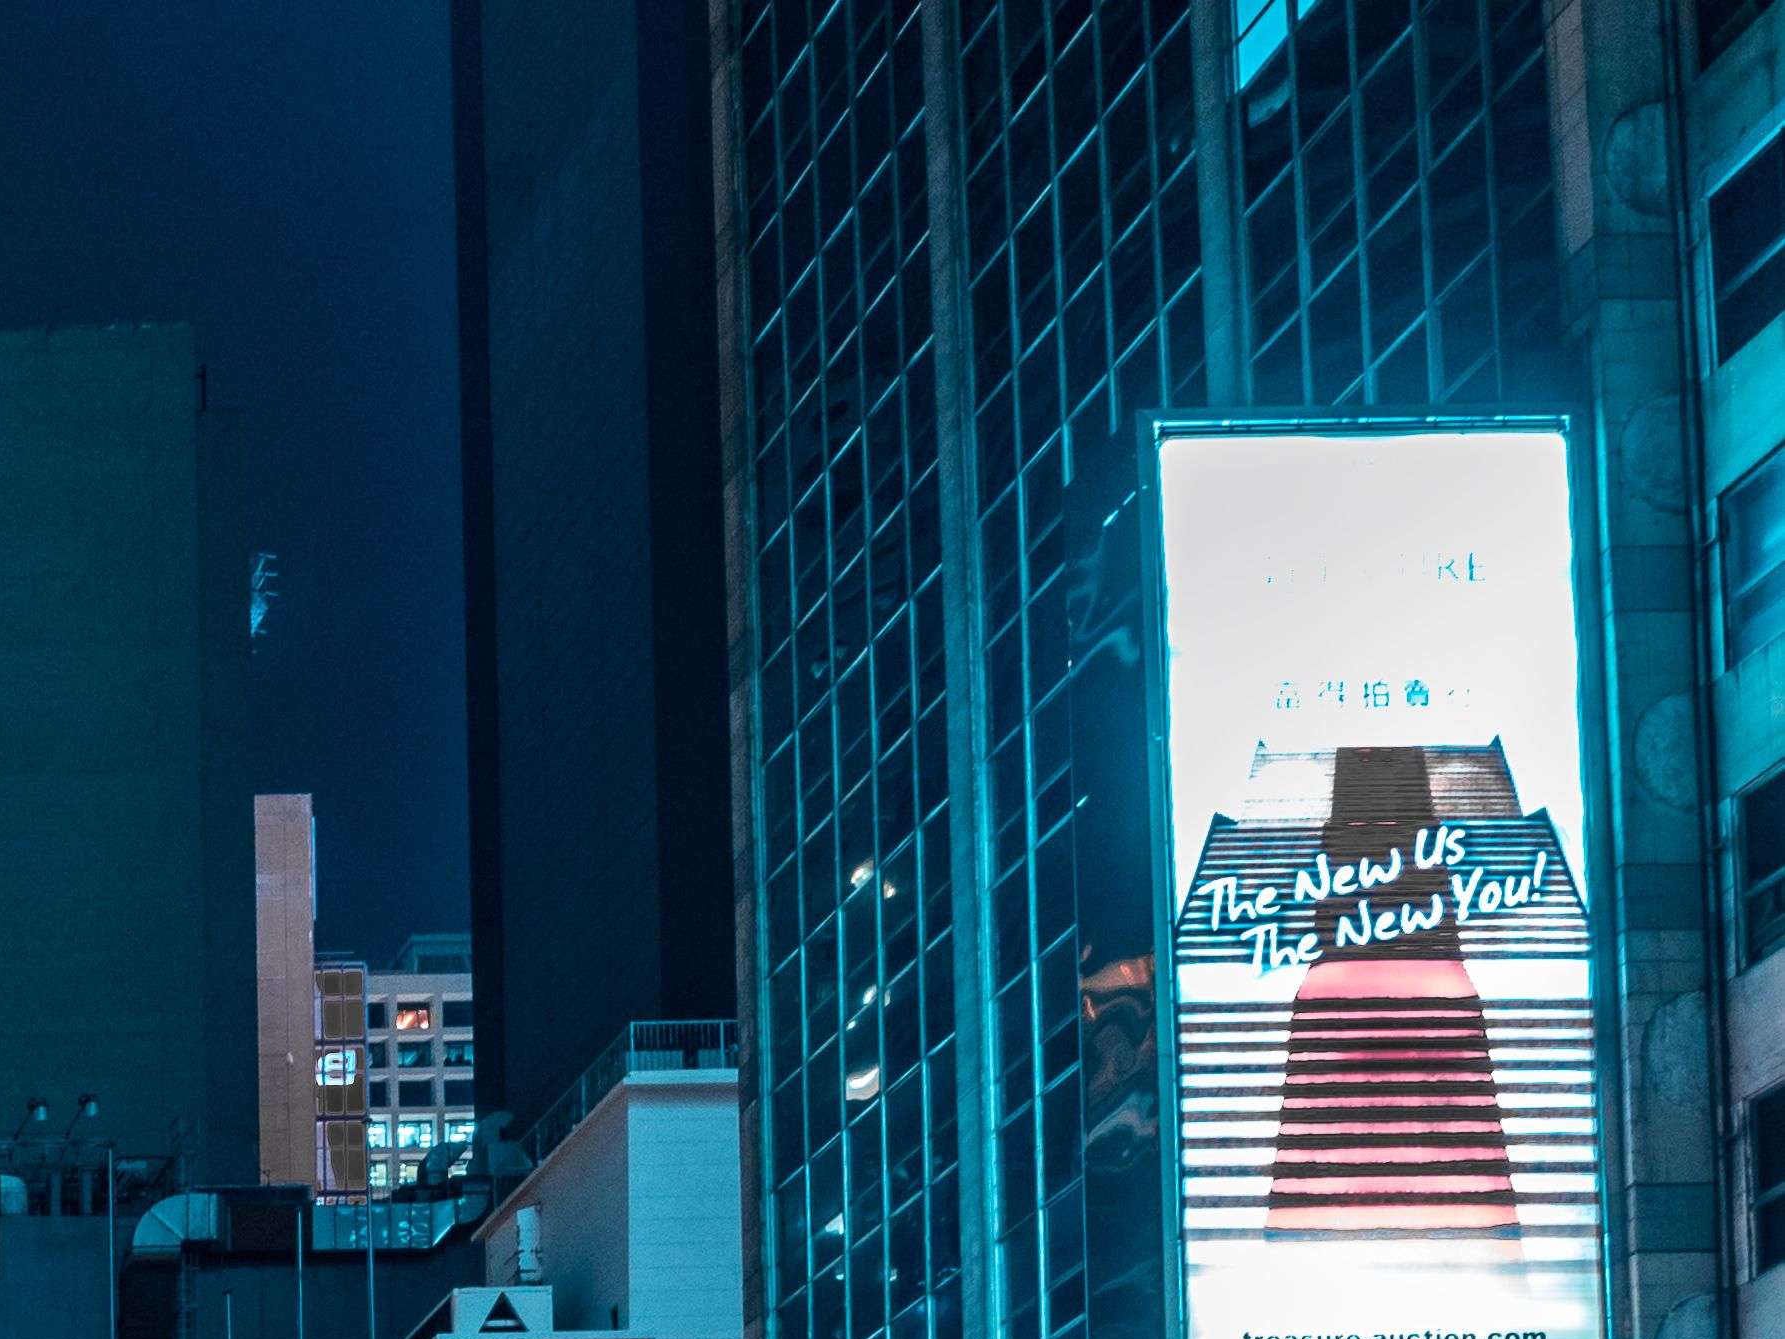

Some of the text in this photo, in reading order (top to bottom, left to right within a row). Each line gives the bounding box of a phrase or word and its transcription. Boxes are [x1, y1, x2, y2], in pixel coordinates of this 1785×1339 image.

[1198, 875, 1282, 930] The
[1294, 849, 1403, 900] New
[1241, 852, 1547, 977] The New You!
